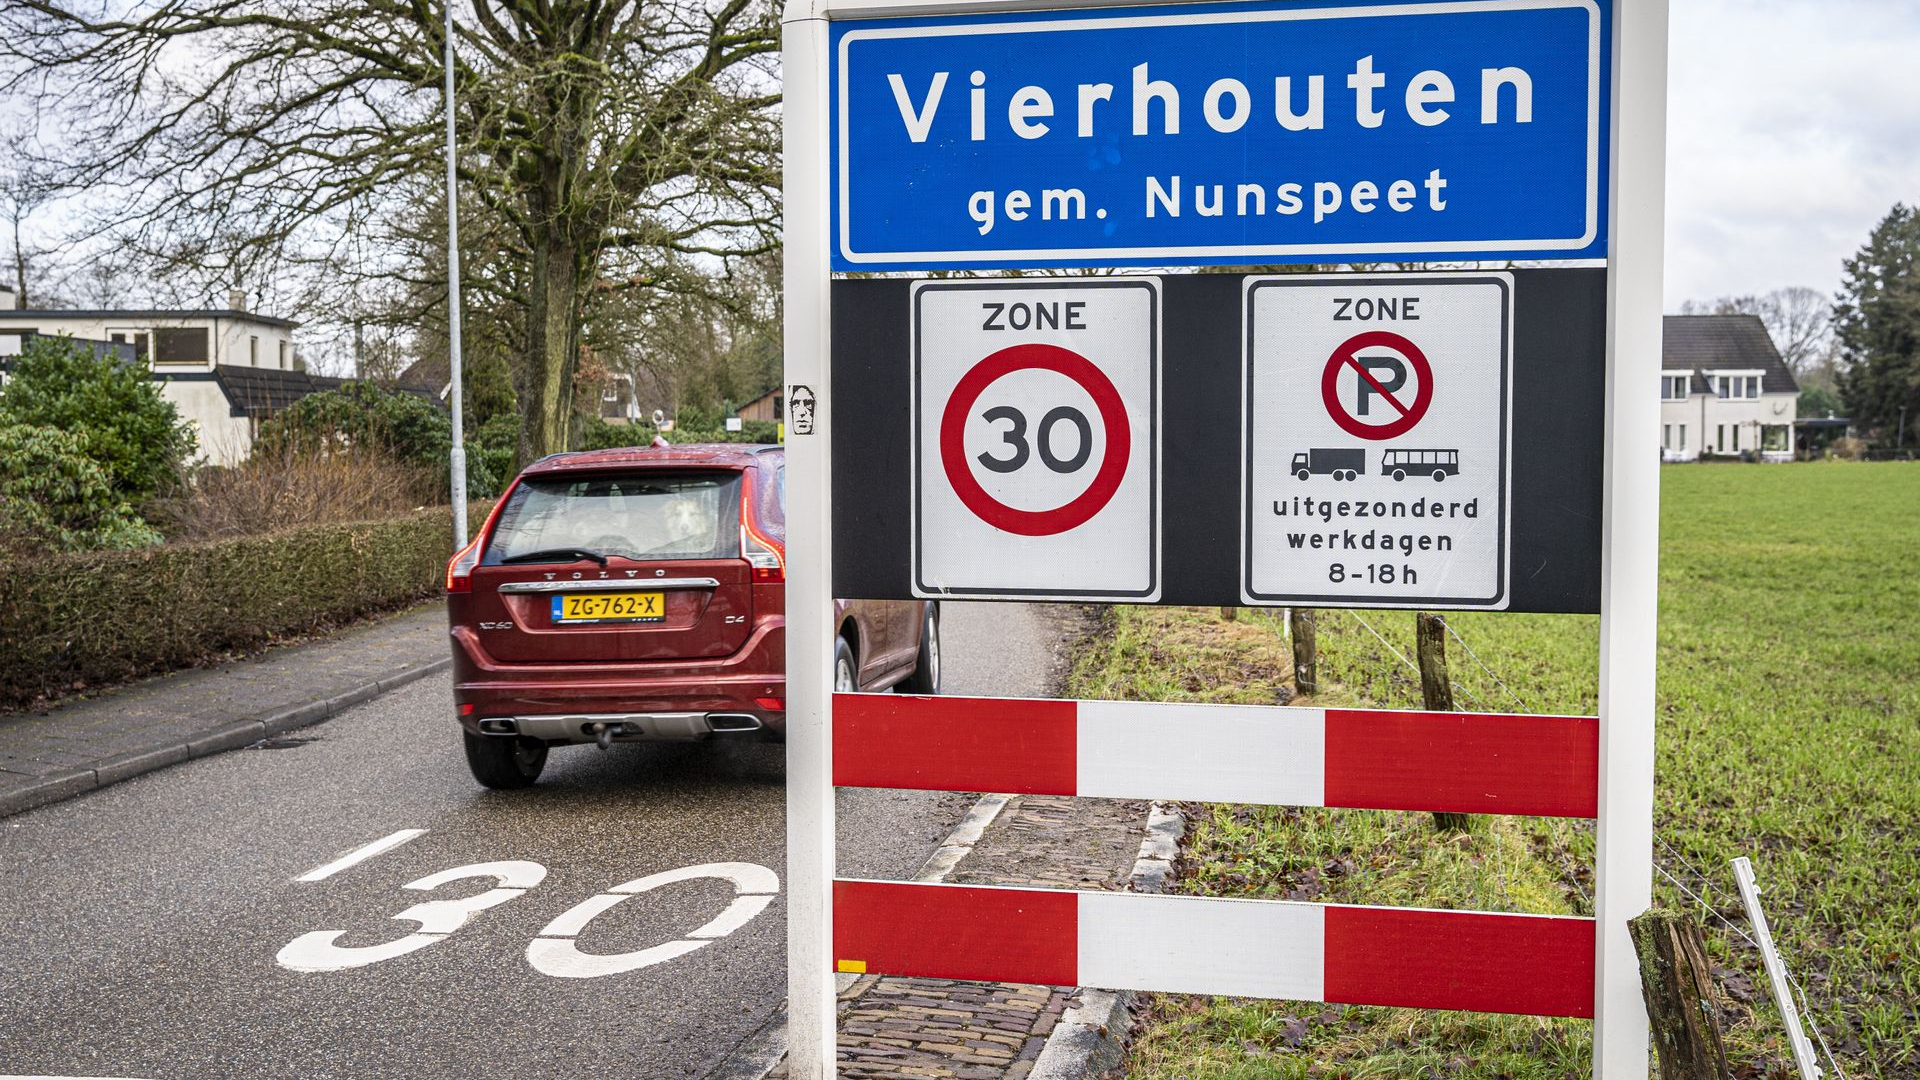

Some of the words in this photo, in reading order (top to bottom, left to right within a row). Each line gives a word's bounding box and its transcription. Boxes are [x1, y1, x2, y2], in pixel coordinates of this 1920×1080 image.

[887, 55, 1534, 143] Vierhouten
[967, 184, 1107, 236] gem.
[1144, 168, 1449, 224] Nunspeet
[982, 301, 1087, 331] ZONE
[1333, 297, 1420, 321] ZONE
[977, 405, 1093, 474] 30
[1273, 496, 1478, 523] uitgezonderd
[1287, 528, 1452, 556] werkdagen
[543, 569, 666, 580] VOLVO
[569, 596, 656, 616] ZG-762-X
[724, 615, 745, 624] D4
[479, 621, 513, 630] XC60
[275, 859, 782, 979] 30
